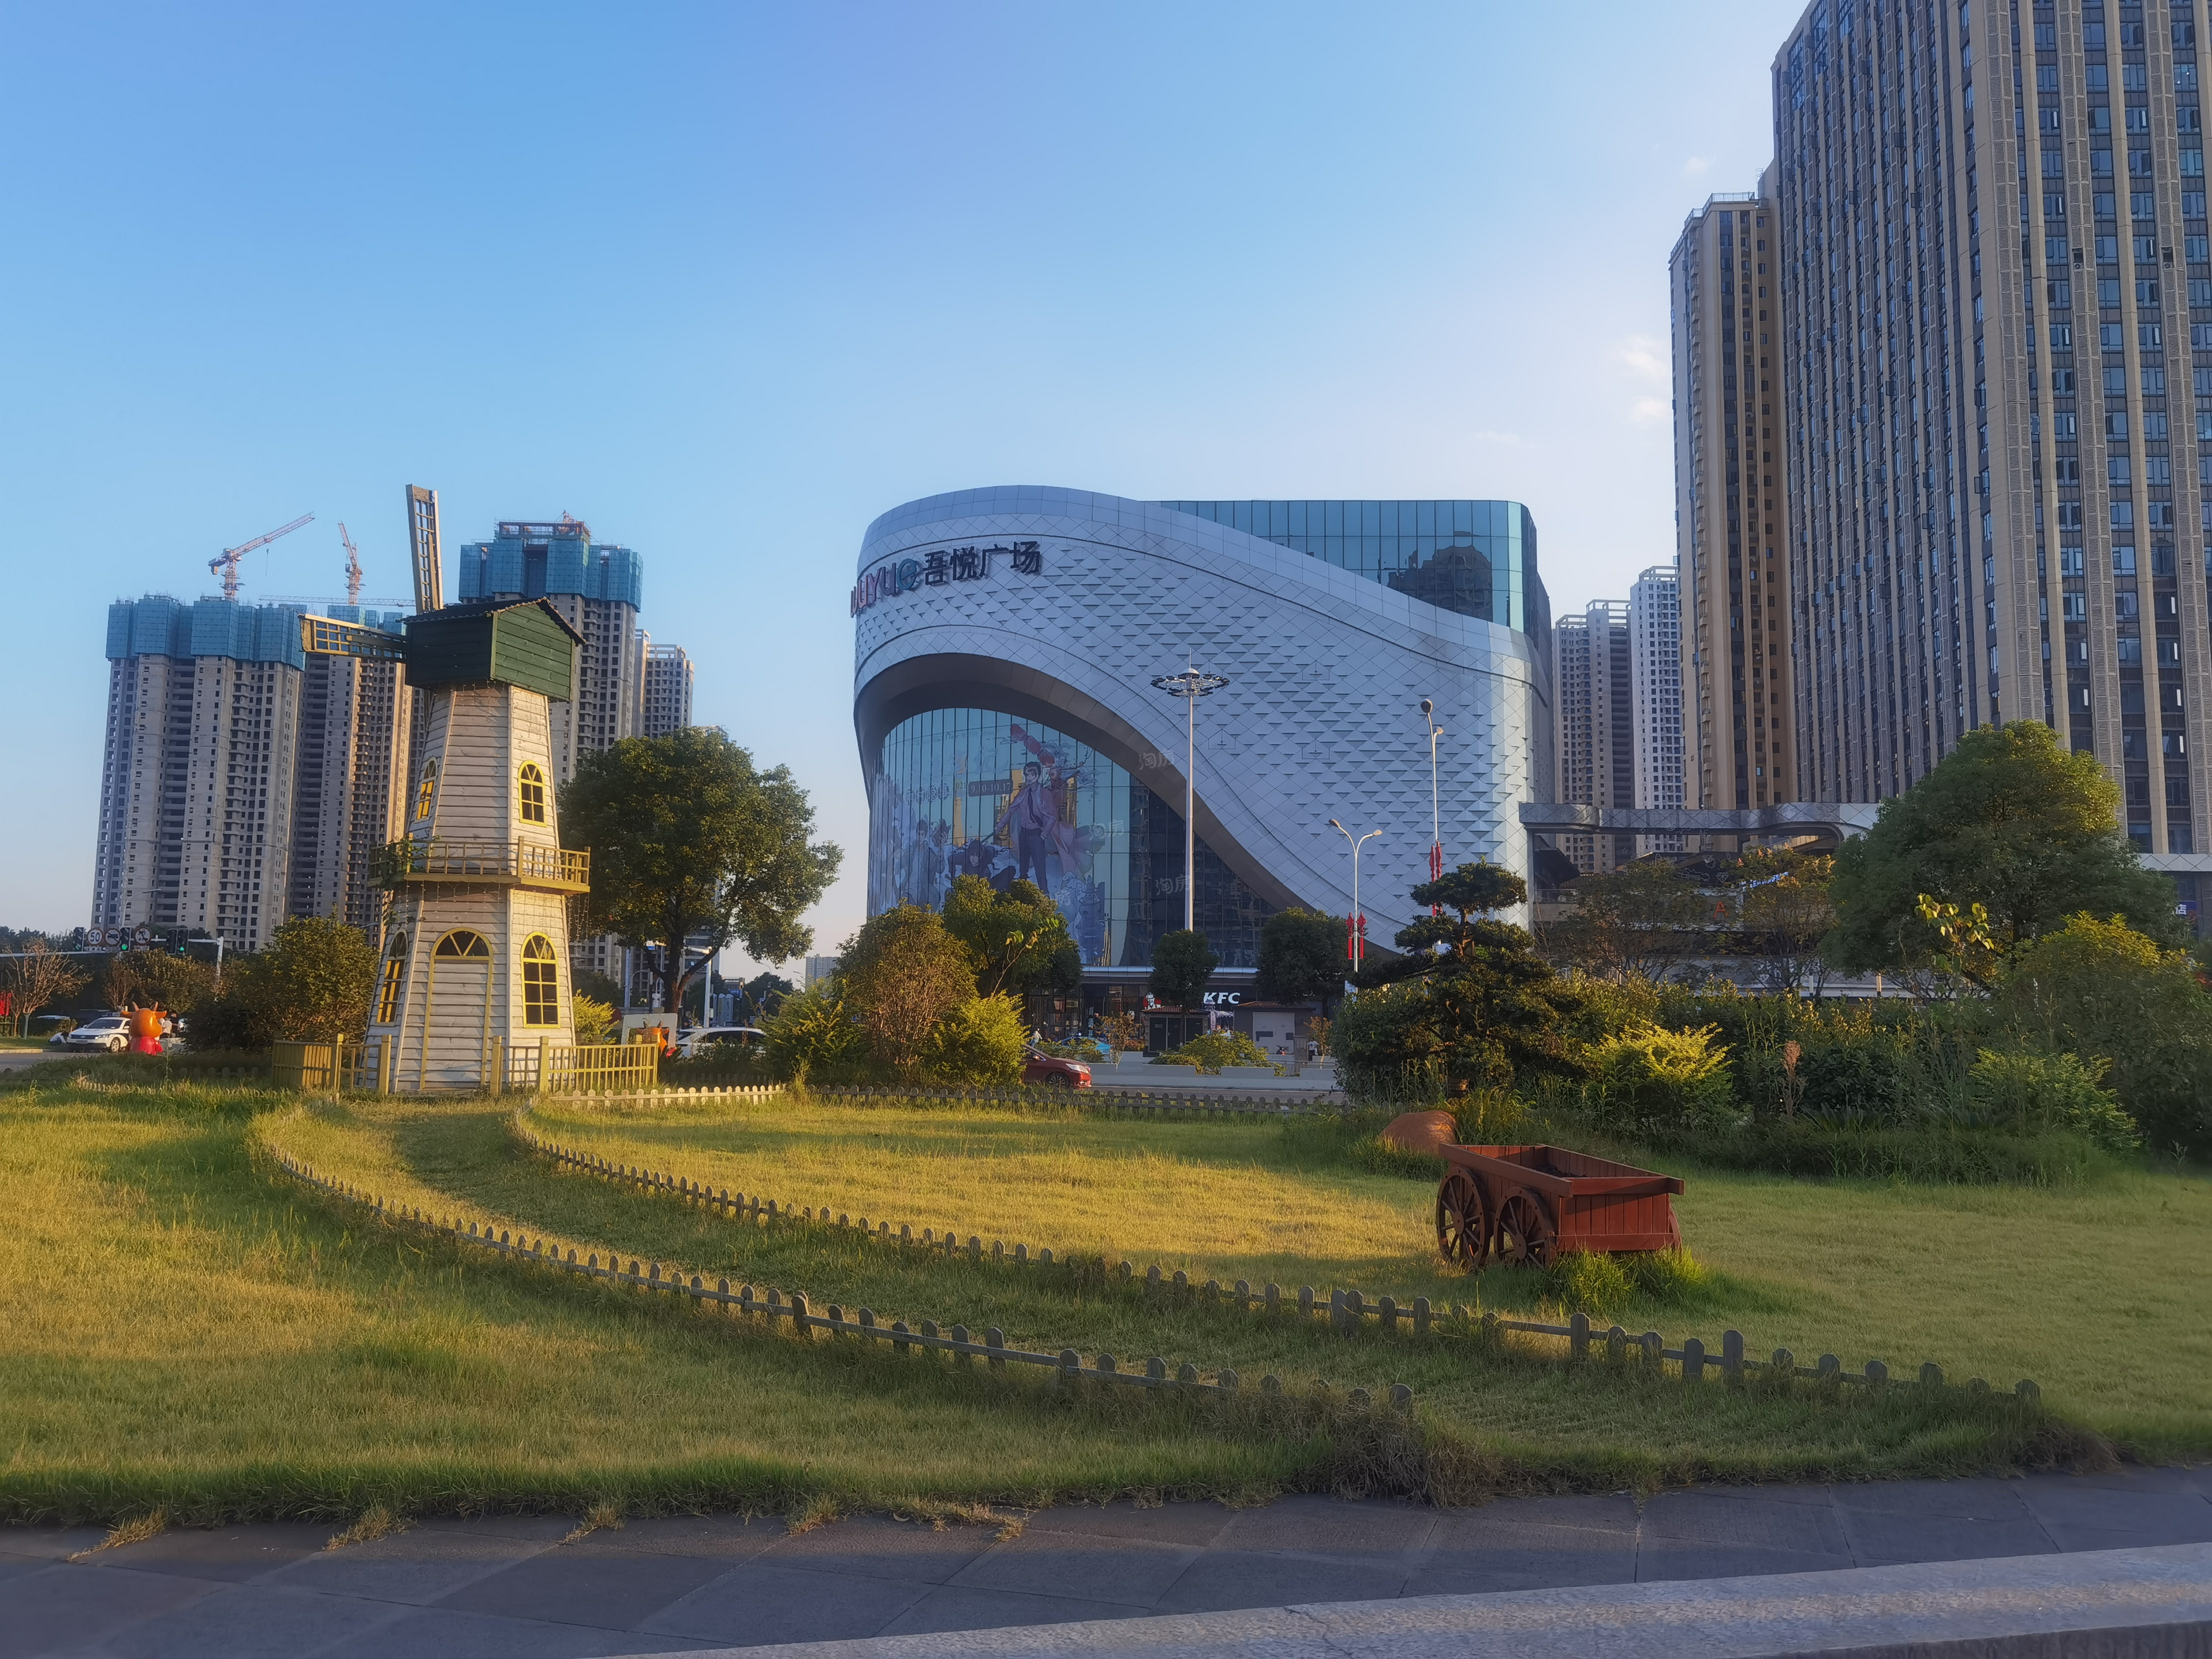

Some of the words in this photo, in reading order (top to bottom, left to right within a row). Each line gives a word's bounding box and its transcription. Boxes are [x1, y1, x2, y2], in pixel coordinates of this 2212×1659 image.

[922, 541, 1041, 585] 吾悦广场
[1713, 901, 1730, 919] A
[2175, 903, 2187, 915] 店
[90, 932, 100, 942] 50
[1203, 992, 1240, 1004] KFC
